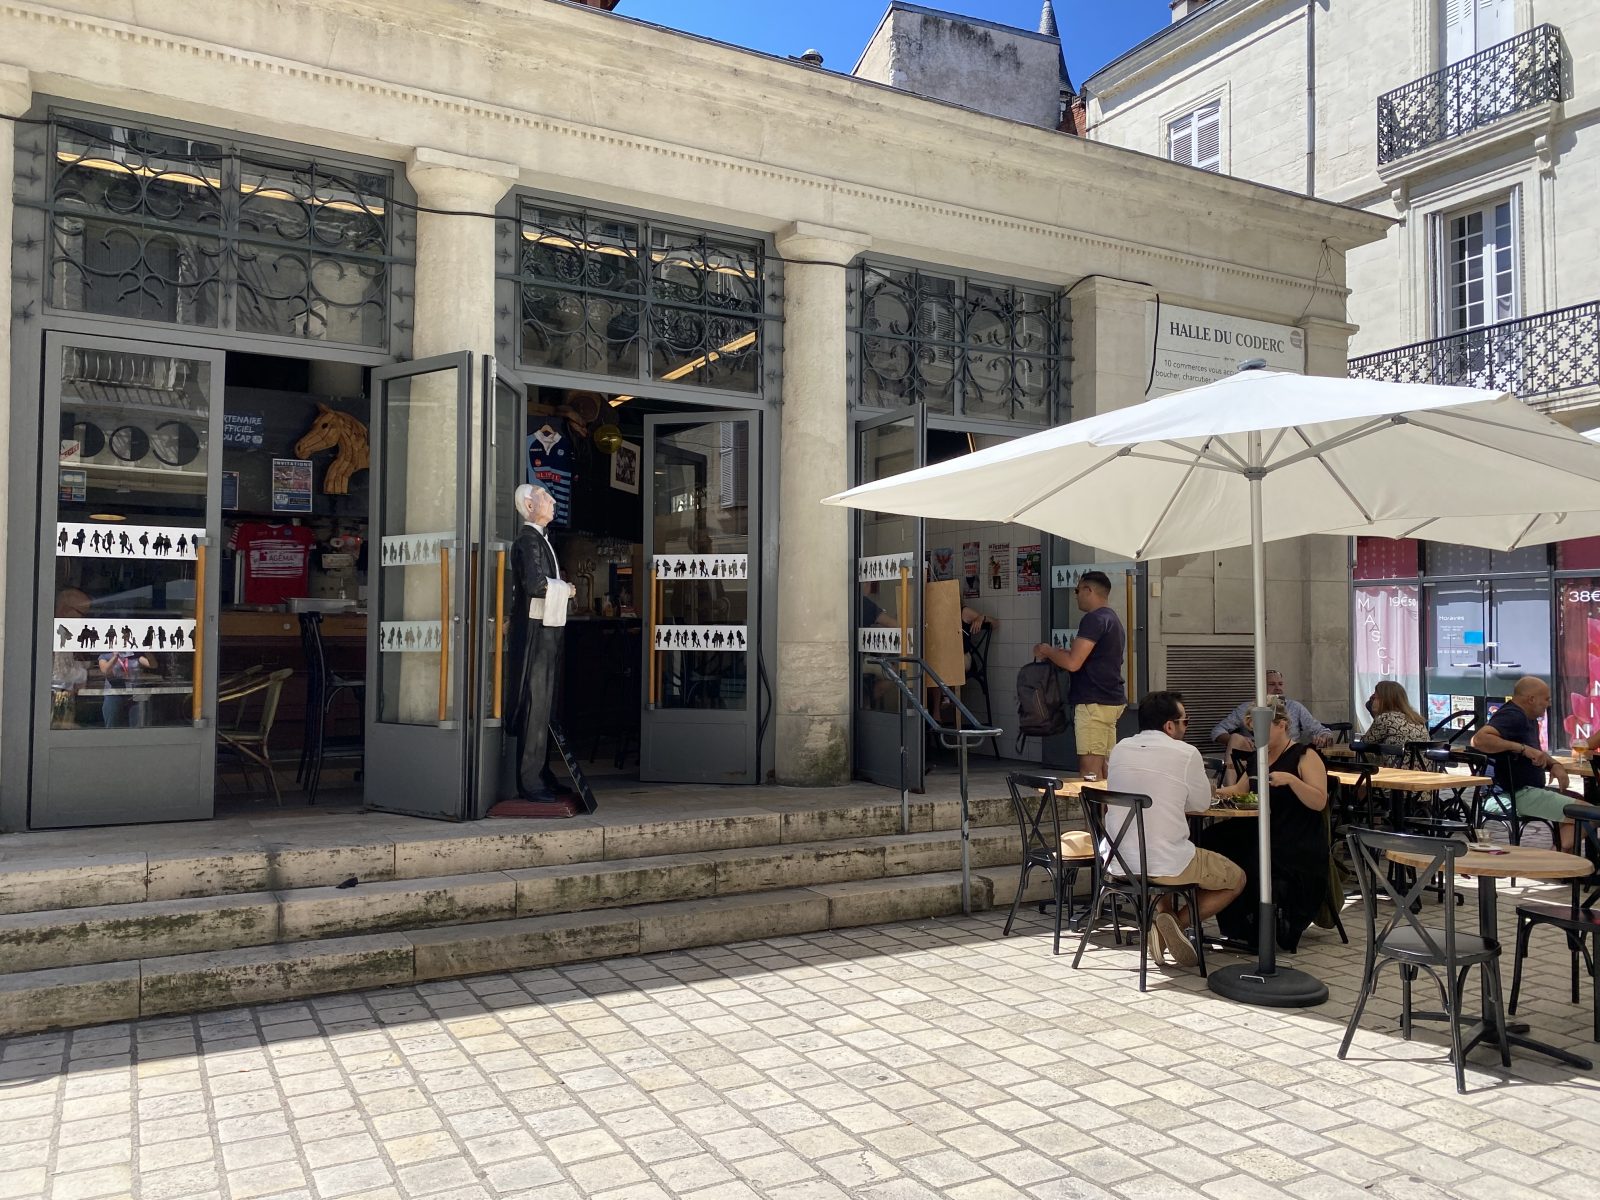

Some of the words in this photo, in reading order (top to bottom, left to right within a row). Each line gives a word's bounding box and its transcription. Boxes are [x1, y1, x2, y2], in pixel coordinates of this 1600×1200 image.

[1170, 321, 1211, 342] HALLE
[1214, 328, 1232, 345] DU
[1235, 332, 1285, 353] CODERC
[1164, 359, 1172, 367] 10
[1173, 362, 1207, 373] commerces
